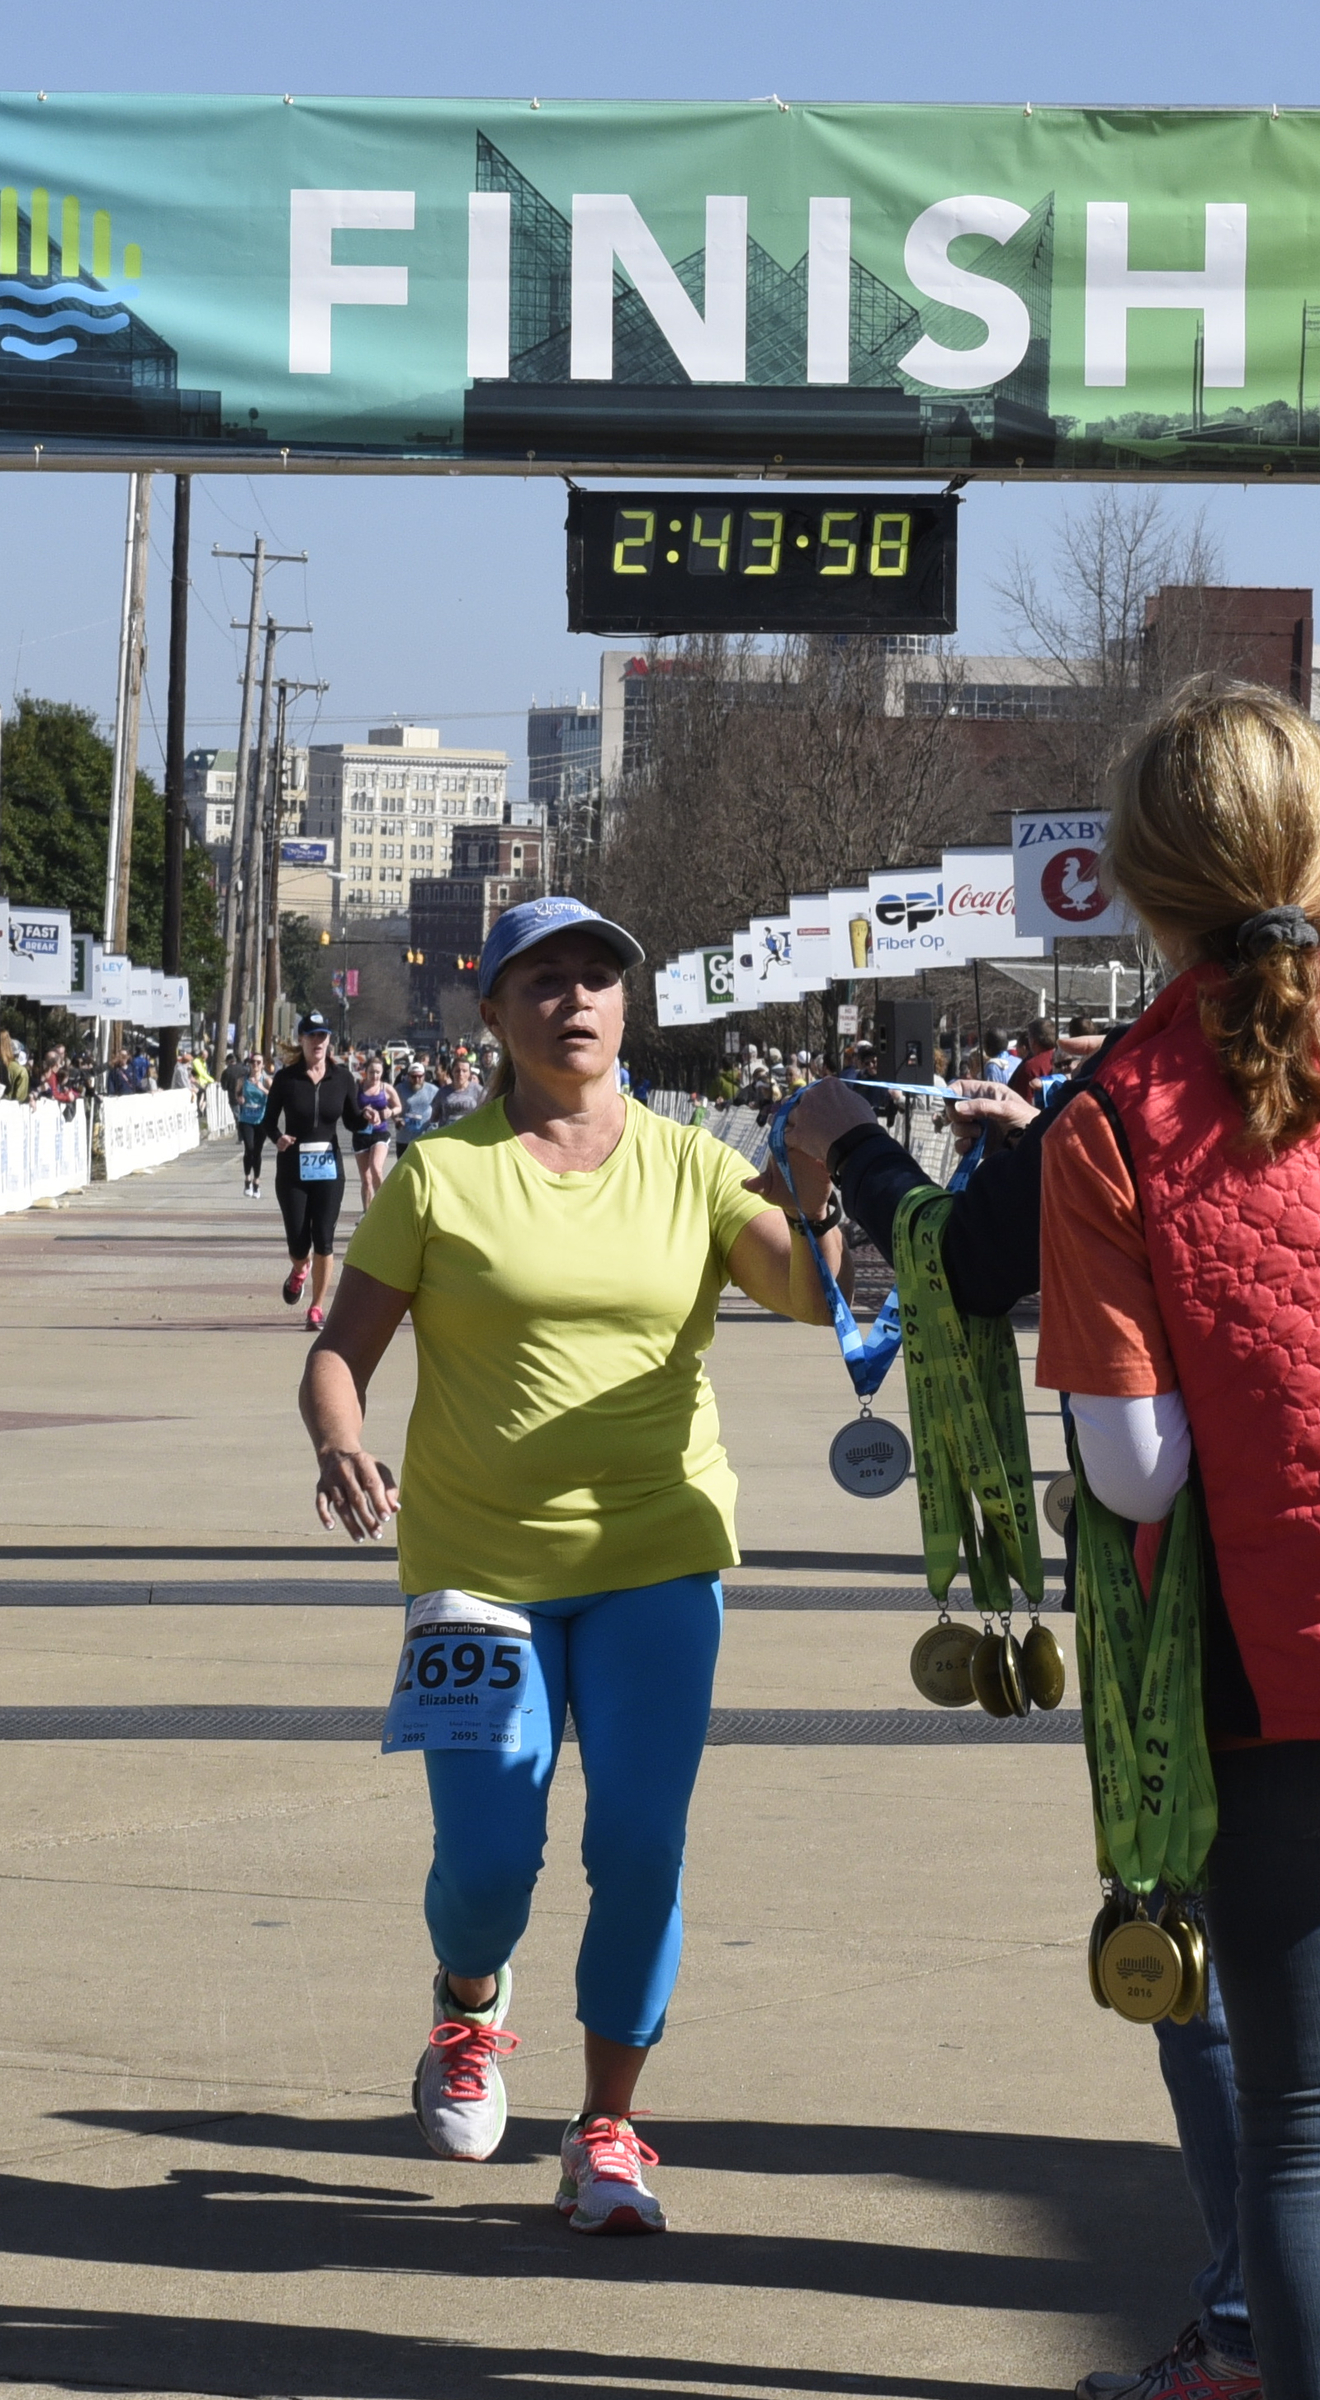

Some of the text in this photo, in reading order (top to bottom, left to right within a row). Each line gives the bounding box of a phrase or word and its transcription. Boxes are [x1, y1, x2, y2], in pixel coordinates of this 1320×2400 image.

[289, 189, 1247, 390] FINISH
[25, 926, 57, 939] FAST
[875, 882, 944, 933] ep
[24, 941, 55, 951] BREAK
[102, 962, 124, 973] LEY
[877, 934, 945, 951] Fiber Op
[921, 1230, 943, 1292] 26.2
[903, 1303, 925, 1365] 26.2
[945, 1321, 962, 1371] MARATHON
[914, 1376, 929, 1445] CHATTANOOGA
[968, 1407, 992, 1474] CHATTANOOGA
[859, 1468, 885, 1479] 2016
[927, 1481, 940, 1535] MARATHON
[983, 1485, 1017, 1543] 26.2
[1102, 1541, 1122, 1603] MARATHON
[422, 1623, 486, 1635] half marathon
[395, 1642, 522, 1694] 2695
[935, 1657, 969, 1673] 26.2
[1159, 1642, 1176, 1726] CHATTANOOGA
[418, 1692, 479, 1707] Elizabeth
[402, 1732, 426, 1743] 2695
[451, 1731, 478, 1741] 2695
[490, 1732, 515, 1743] 2695
[1109, 1760, 1125, 1822] MARATHON
[1140, 1737, 1169, 1816] 26.2
[1127, 1986, 1153, 1998] 2016
